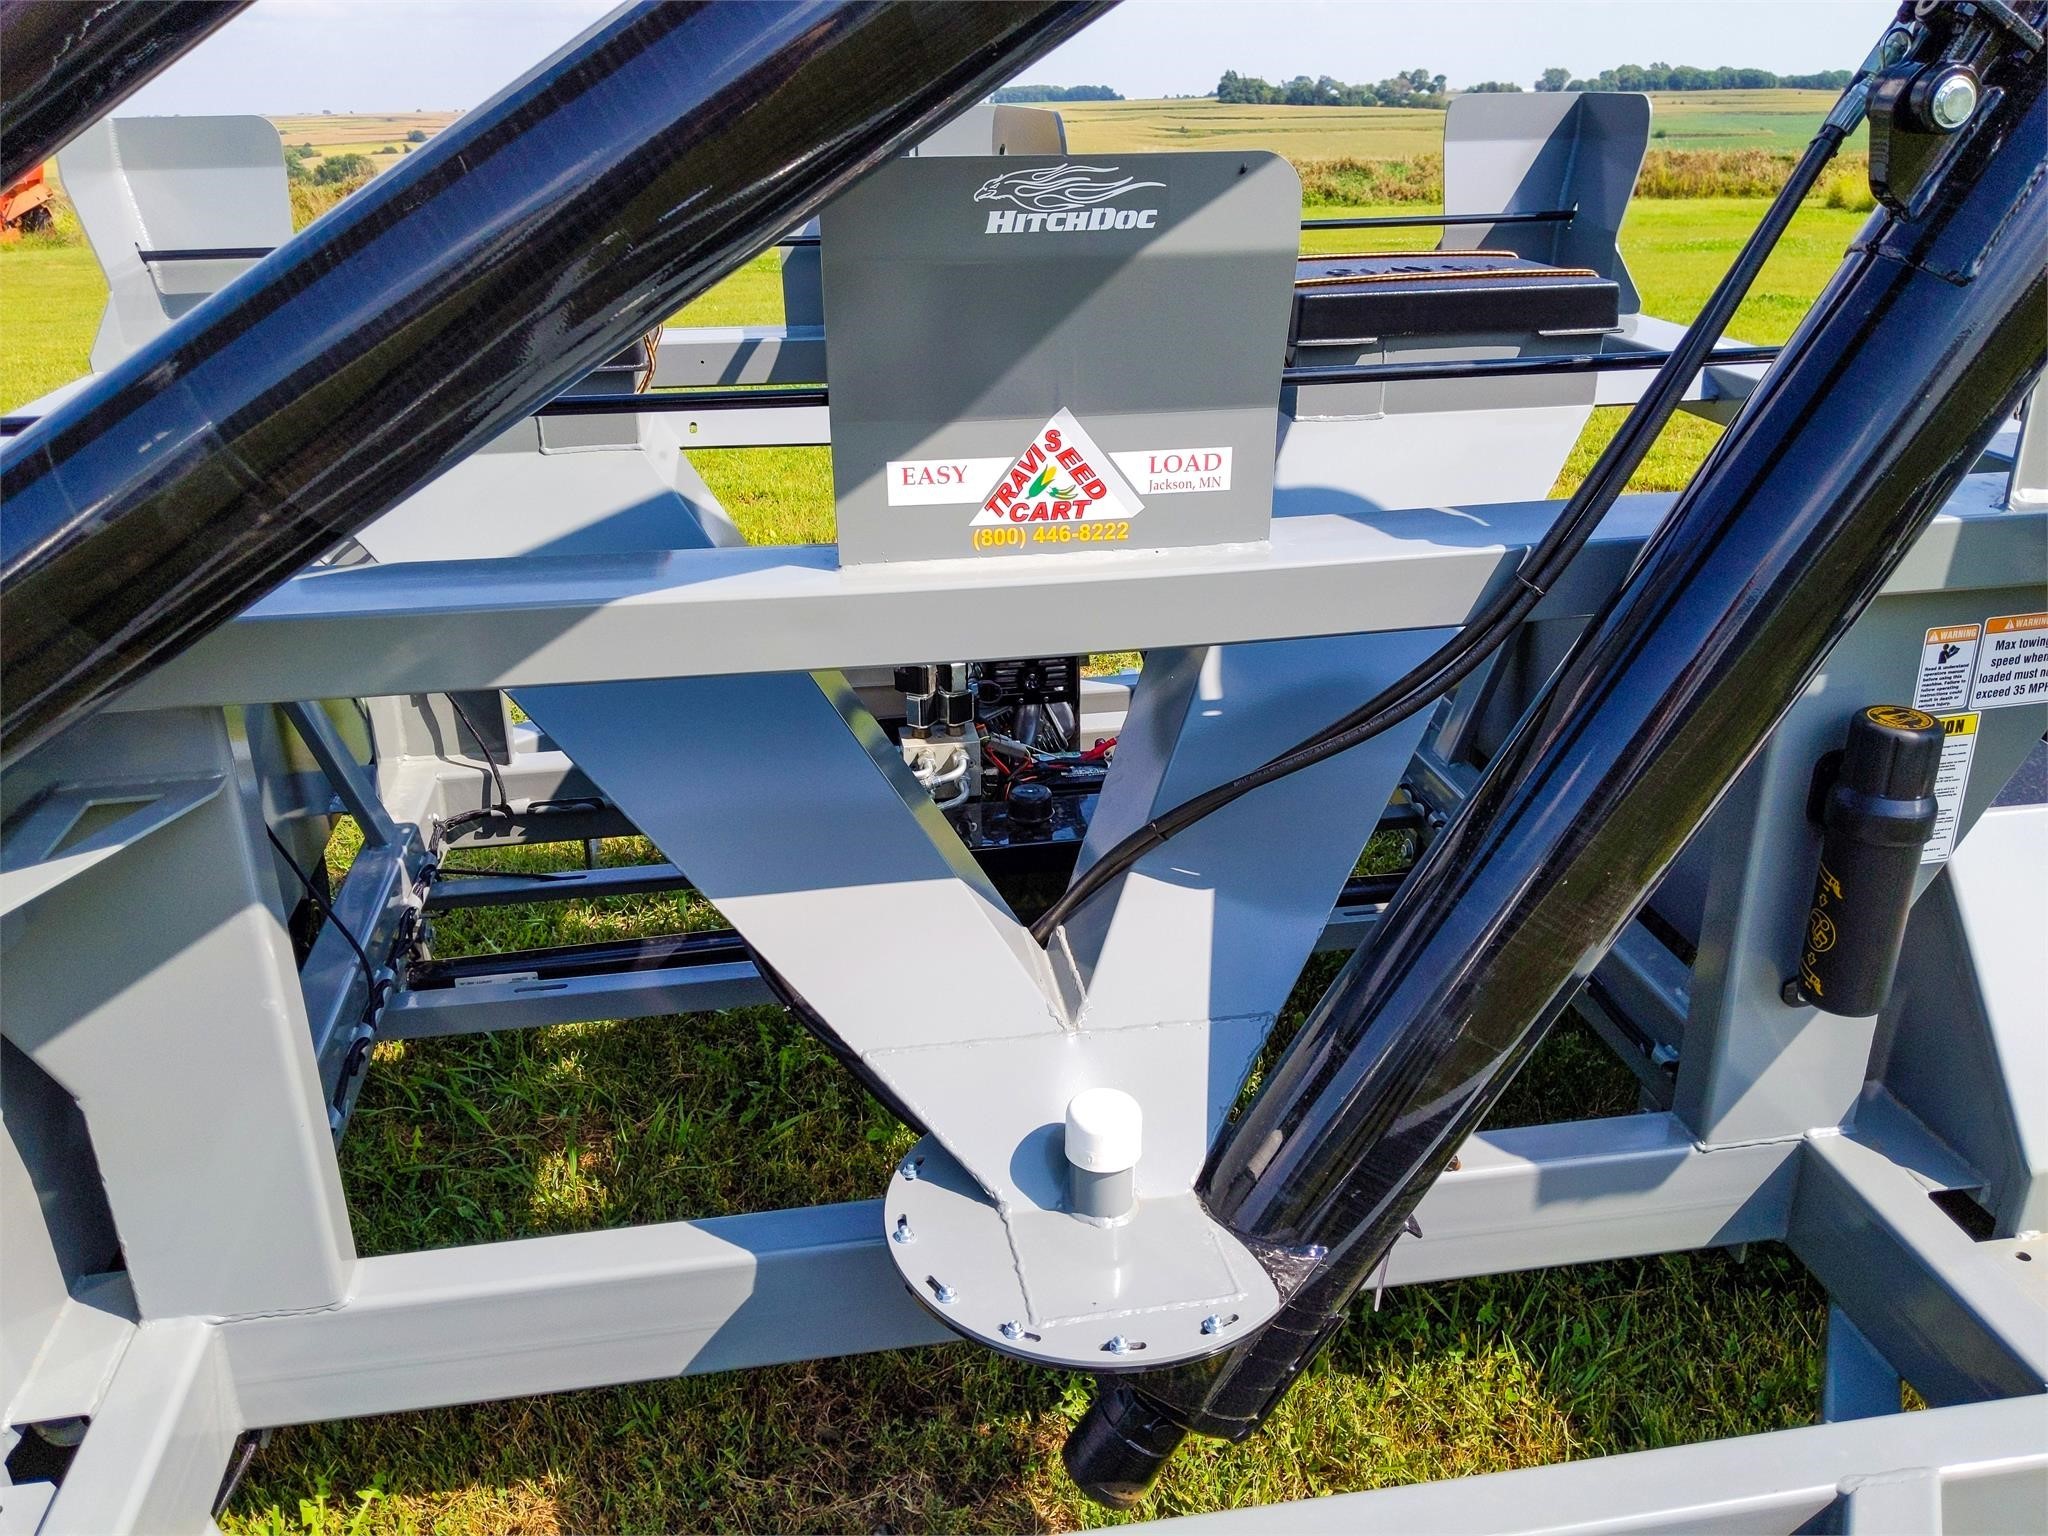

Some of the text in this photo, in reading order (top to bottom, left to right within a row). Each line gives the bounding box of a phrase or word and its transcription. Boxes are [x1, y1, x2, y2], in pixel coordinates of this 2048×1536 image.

[1149, 453, 1222, 474] LOAD
[901, 465, 967, 486] EASY
[1149, 476, 1222, 493] Jackson, MN
[1009, 499, 1092, 522] CART
[973, 521, 1129, 551] (800) 446-8222
[2016, 616, 2048, 628] WARNIN
[1941, 628, 1977, 640] WARNING
[1995, 640, 2017, 651] Max
[1991, 654, 2021, 668] speed
[1978, 670, 2012, 684] loaded
[2014, 668, 2038, 681] must
[1976, 686, 2011, 699] exceed
[2013, 684, 2026, 696] 35
